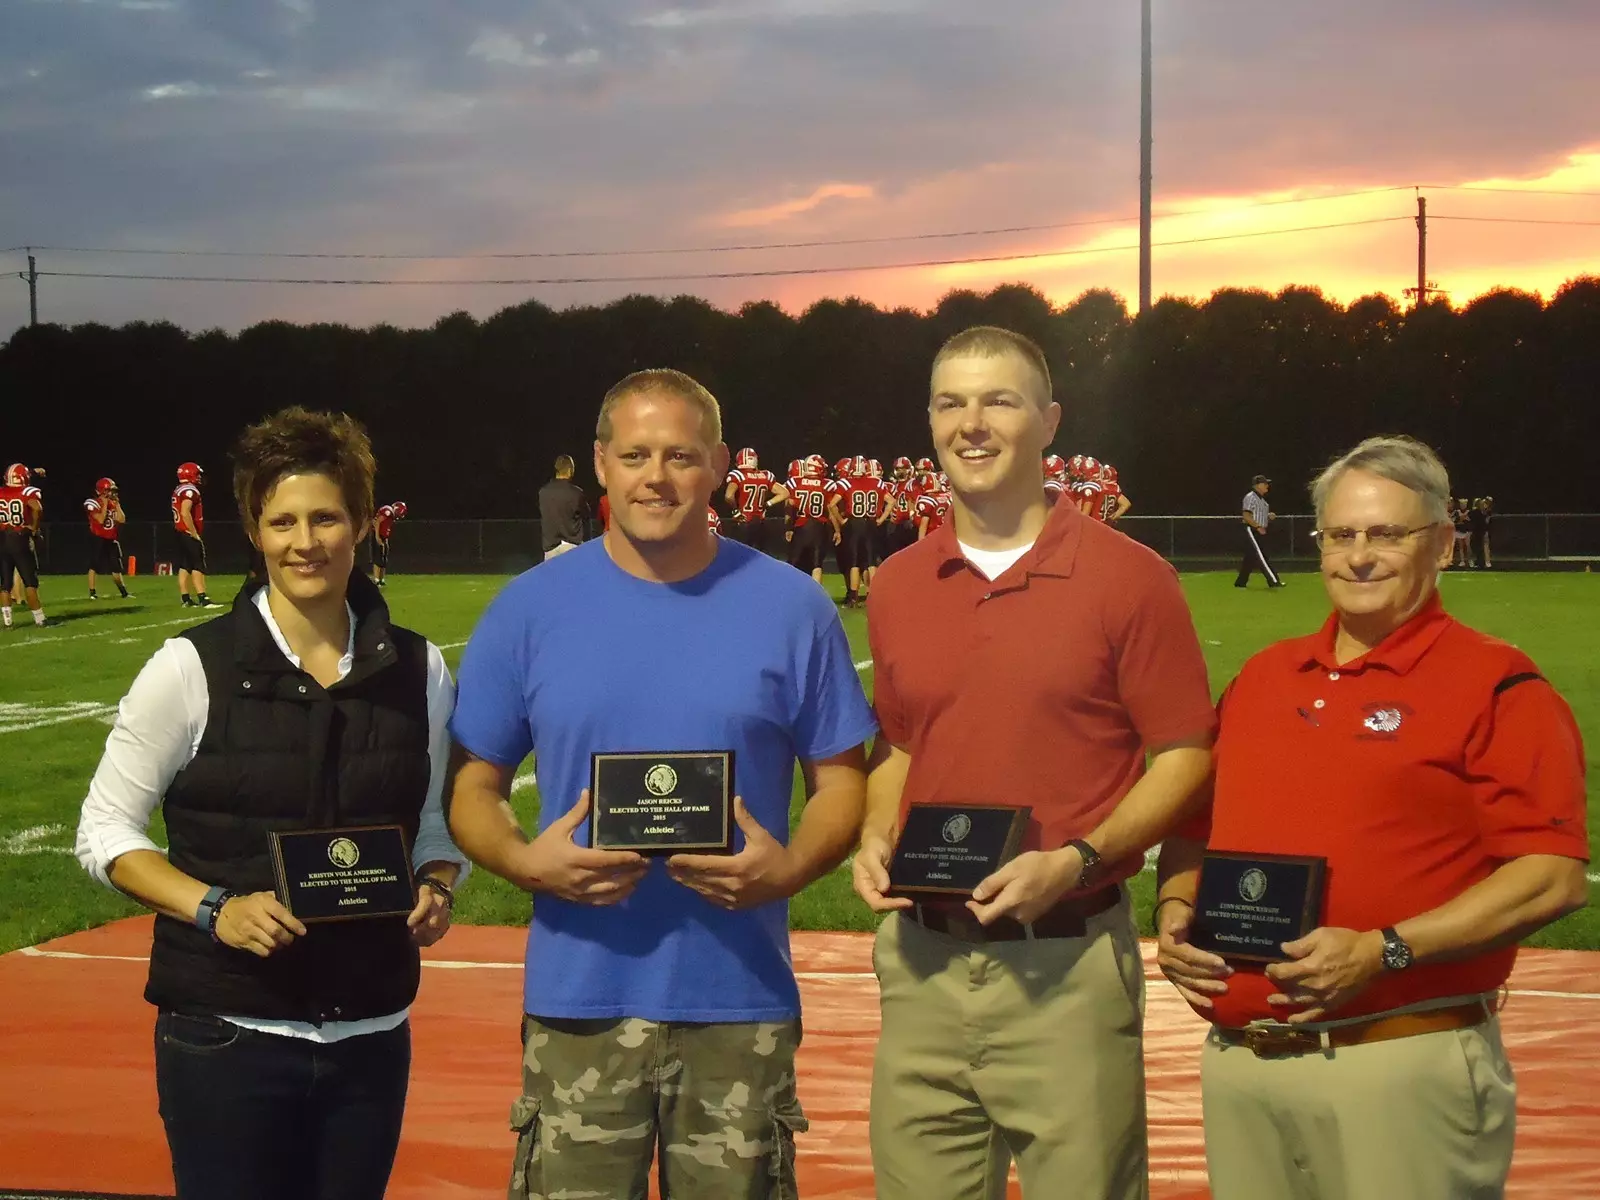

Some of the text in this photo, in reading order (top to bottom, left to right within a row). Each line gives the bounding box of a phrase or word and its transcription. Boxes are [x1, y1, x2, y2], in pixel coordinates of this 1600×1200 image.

[795, 490, 824, 518] 78
[852, 490, 878, 518] 88
[0, 499, 25, 527] 68
[643, 826, 675, 834] Athletics
[308, 871, 335, 879] KRISTIN
[353, 868, 387, 876] ANDERSON
[300, 880, 329, 888] ELECTED
[338, 897, 368, 906] Athletics
[1215, 932, 1244, 944] Coaching
[1251, 936, 1274, 946] Service
